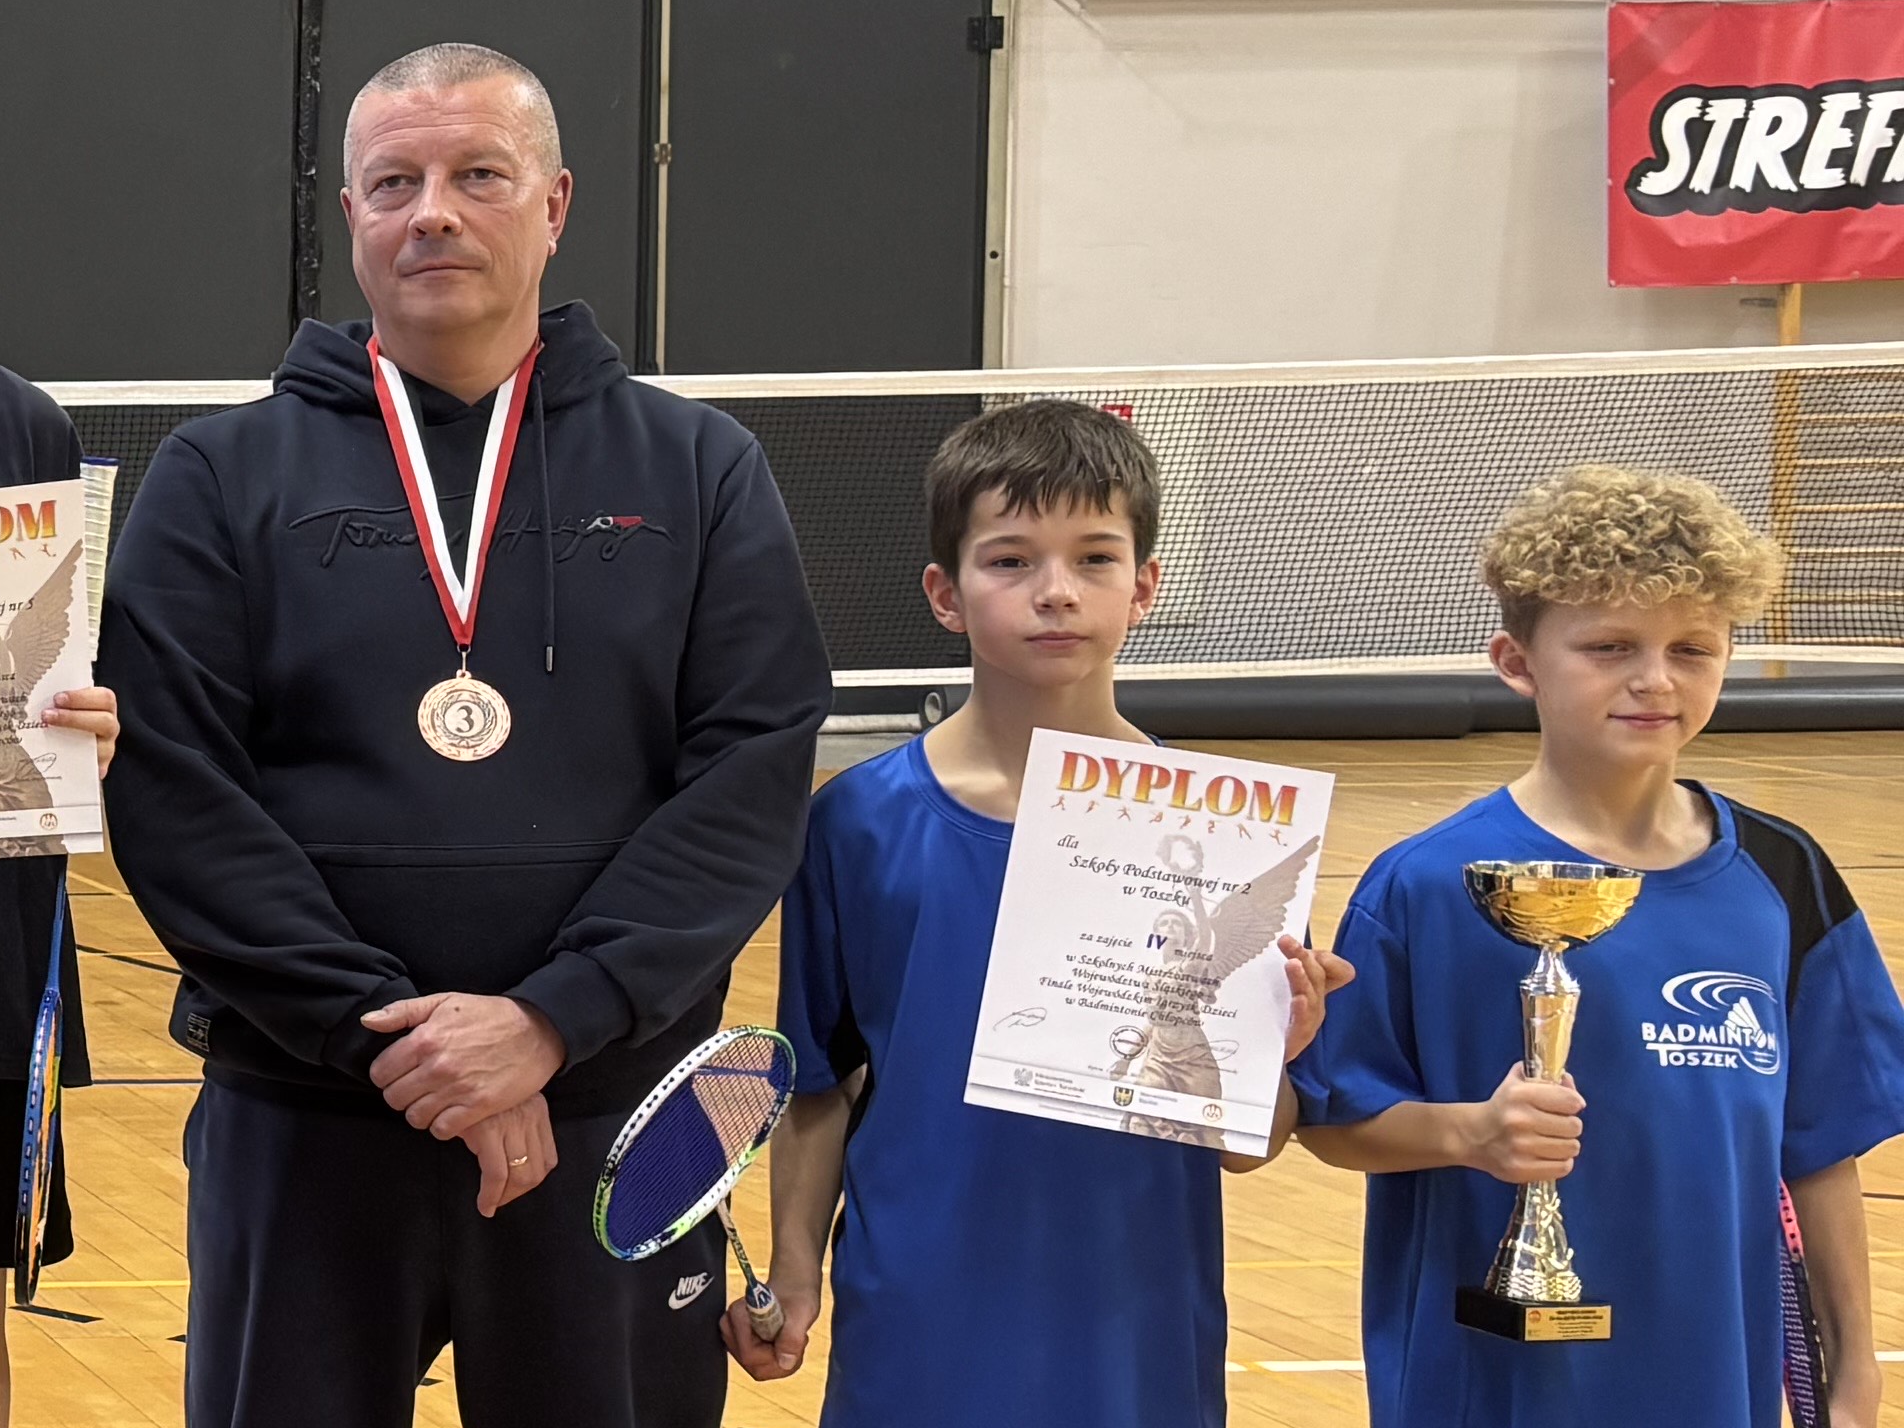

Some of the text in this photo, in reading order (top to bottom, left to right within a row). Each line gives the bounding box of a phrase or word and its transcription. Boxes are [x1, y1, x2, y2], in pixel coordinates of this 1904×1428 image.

[454, 704, 476, 734] 3
[1056, 750, 1300, 827] DYPLOM
[1057, 834, 1080, 849] dla
[1068, 854, 1252, 895] Szkoły Podstawowej nr 2
[1122, 885, 1193, 908] w Toszku
[1146, 933, 1168, 950] IV
[1645, 1042, 1740, 1069] TOSZEK
[677, 1272, 708, 1297] NIKE
